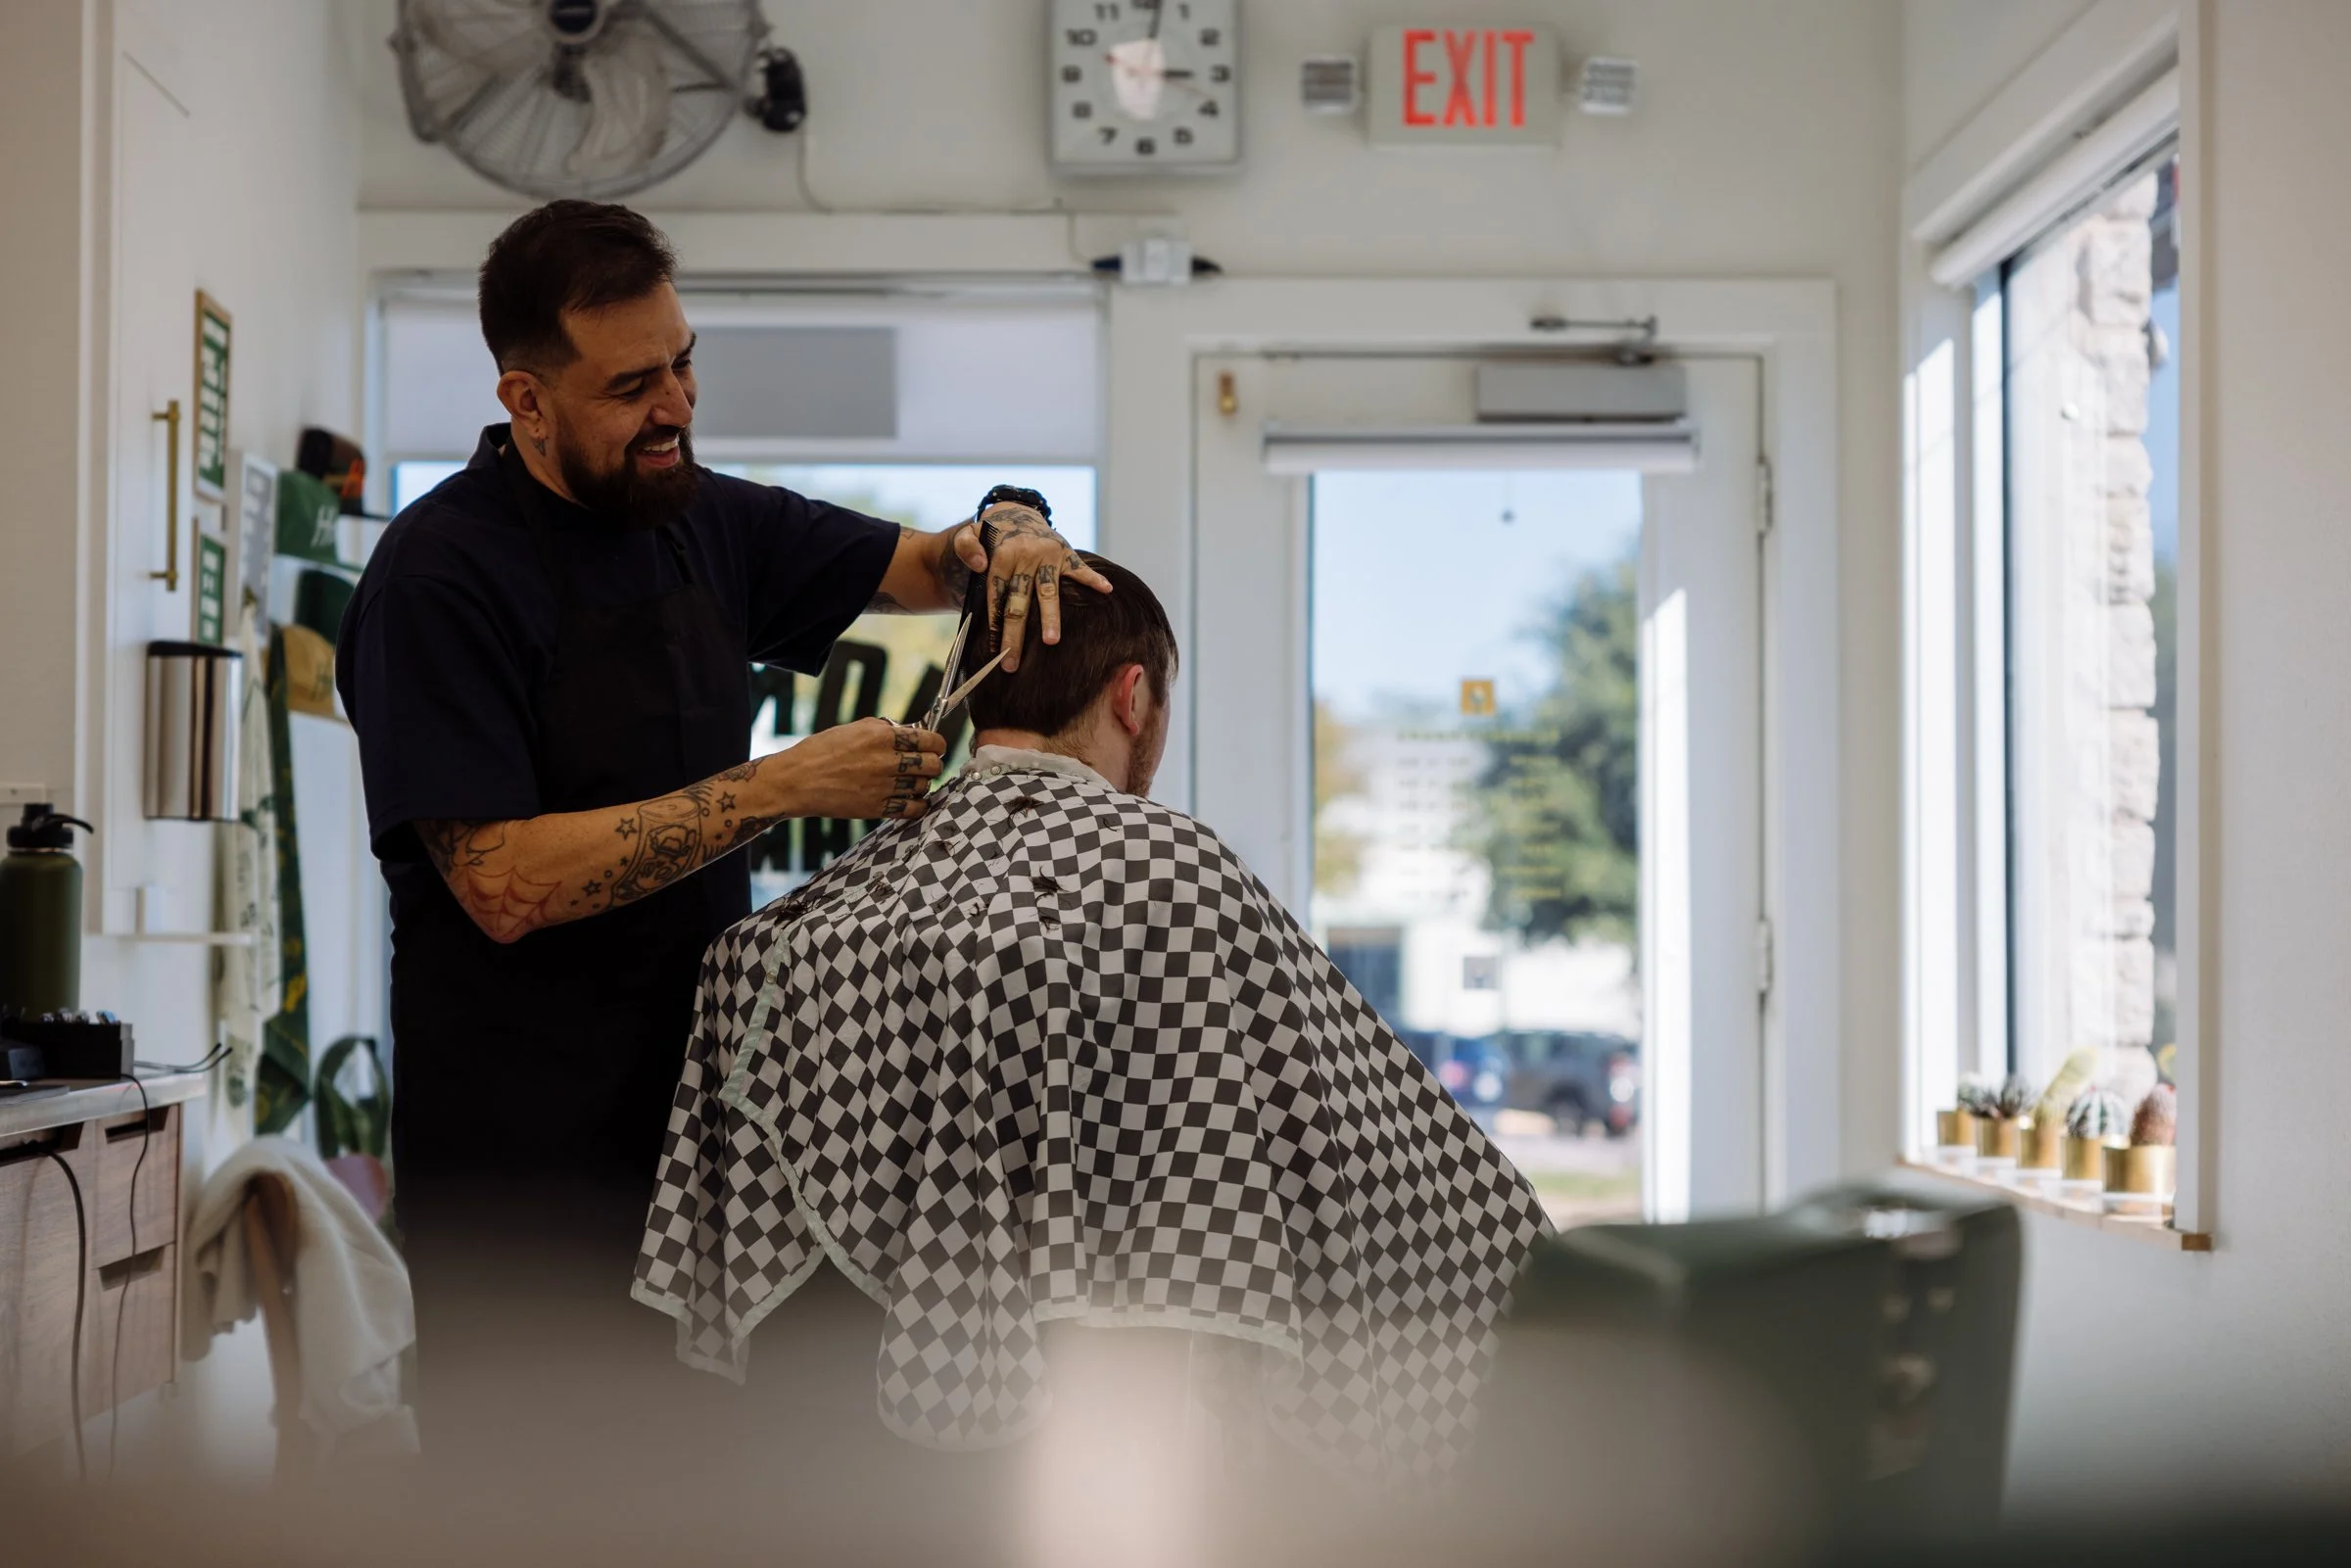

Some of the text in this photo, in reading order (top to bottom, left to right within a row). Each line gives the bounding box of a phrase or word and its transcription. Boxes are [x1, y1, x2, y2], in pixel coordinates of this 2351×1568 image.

[1095, 2, 1121, 21] 11
[1065, 28, 1098, 46] 10
[1210, 65, 1231, 83] 3
[1402, 29, 1535, 127] EXIT
[1197, 100, 1220, 119] 4
[1098, 126, 1119, 145] 7
